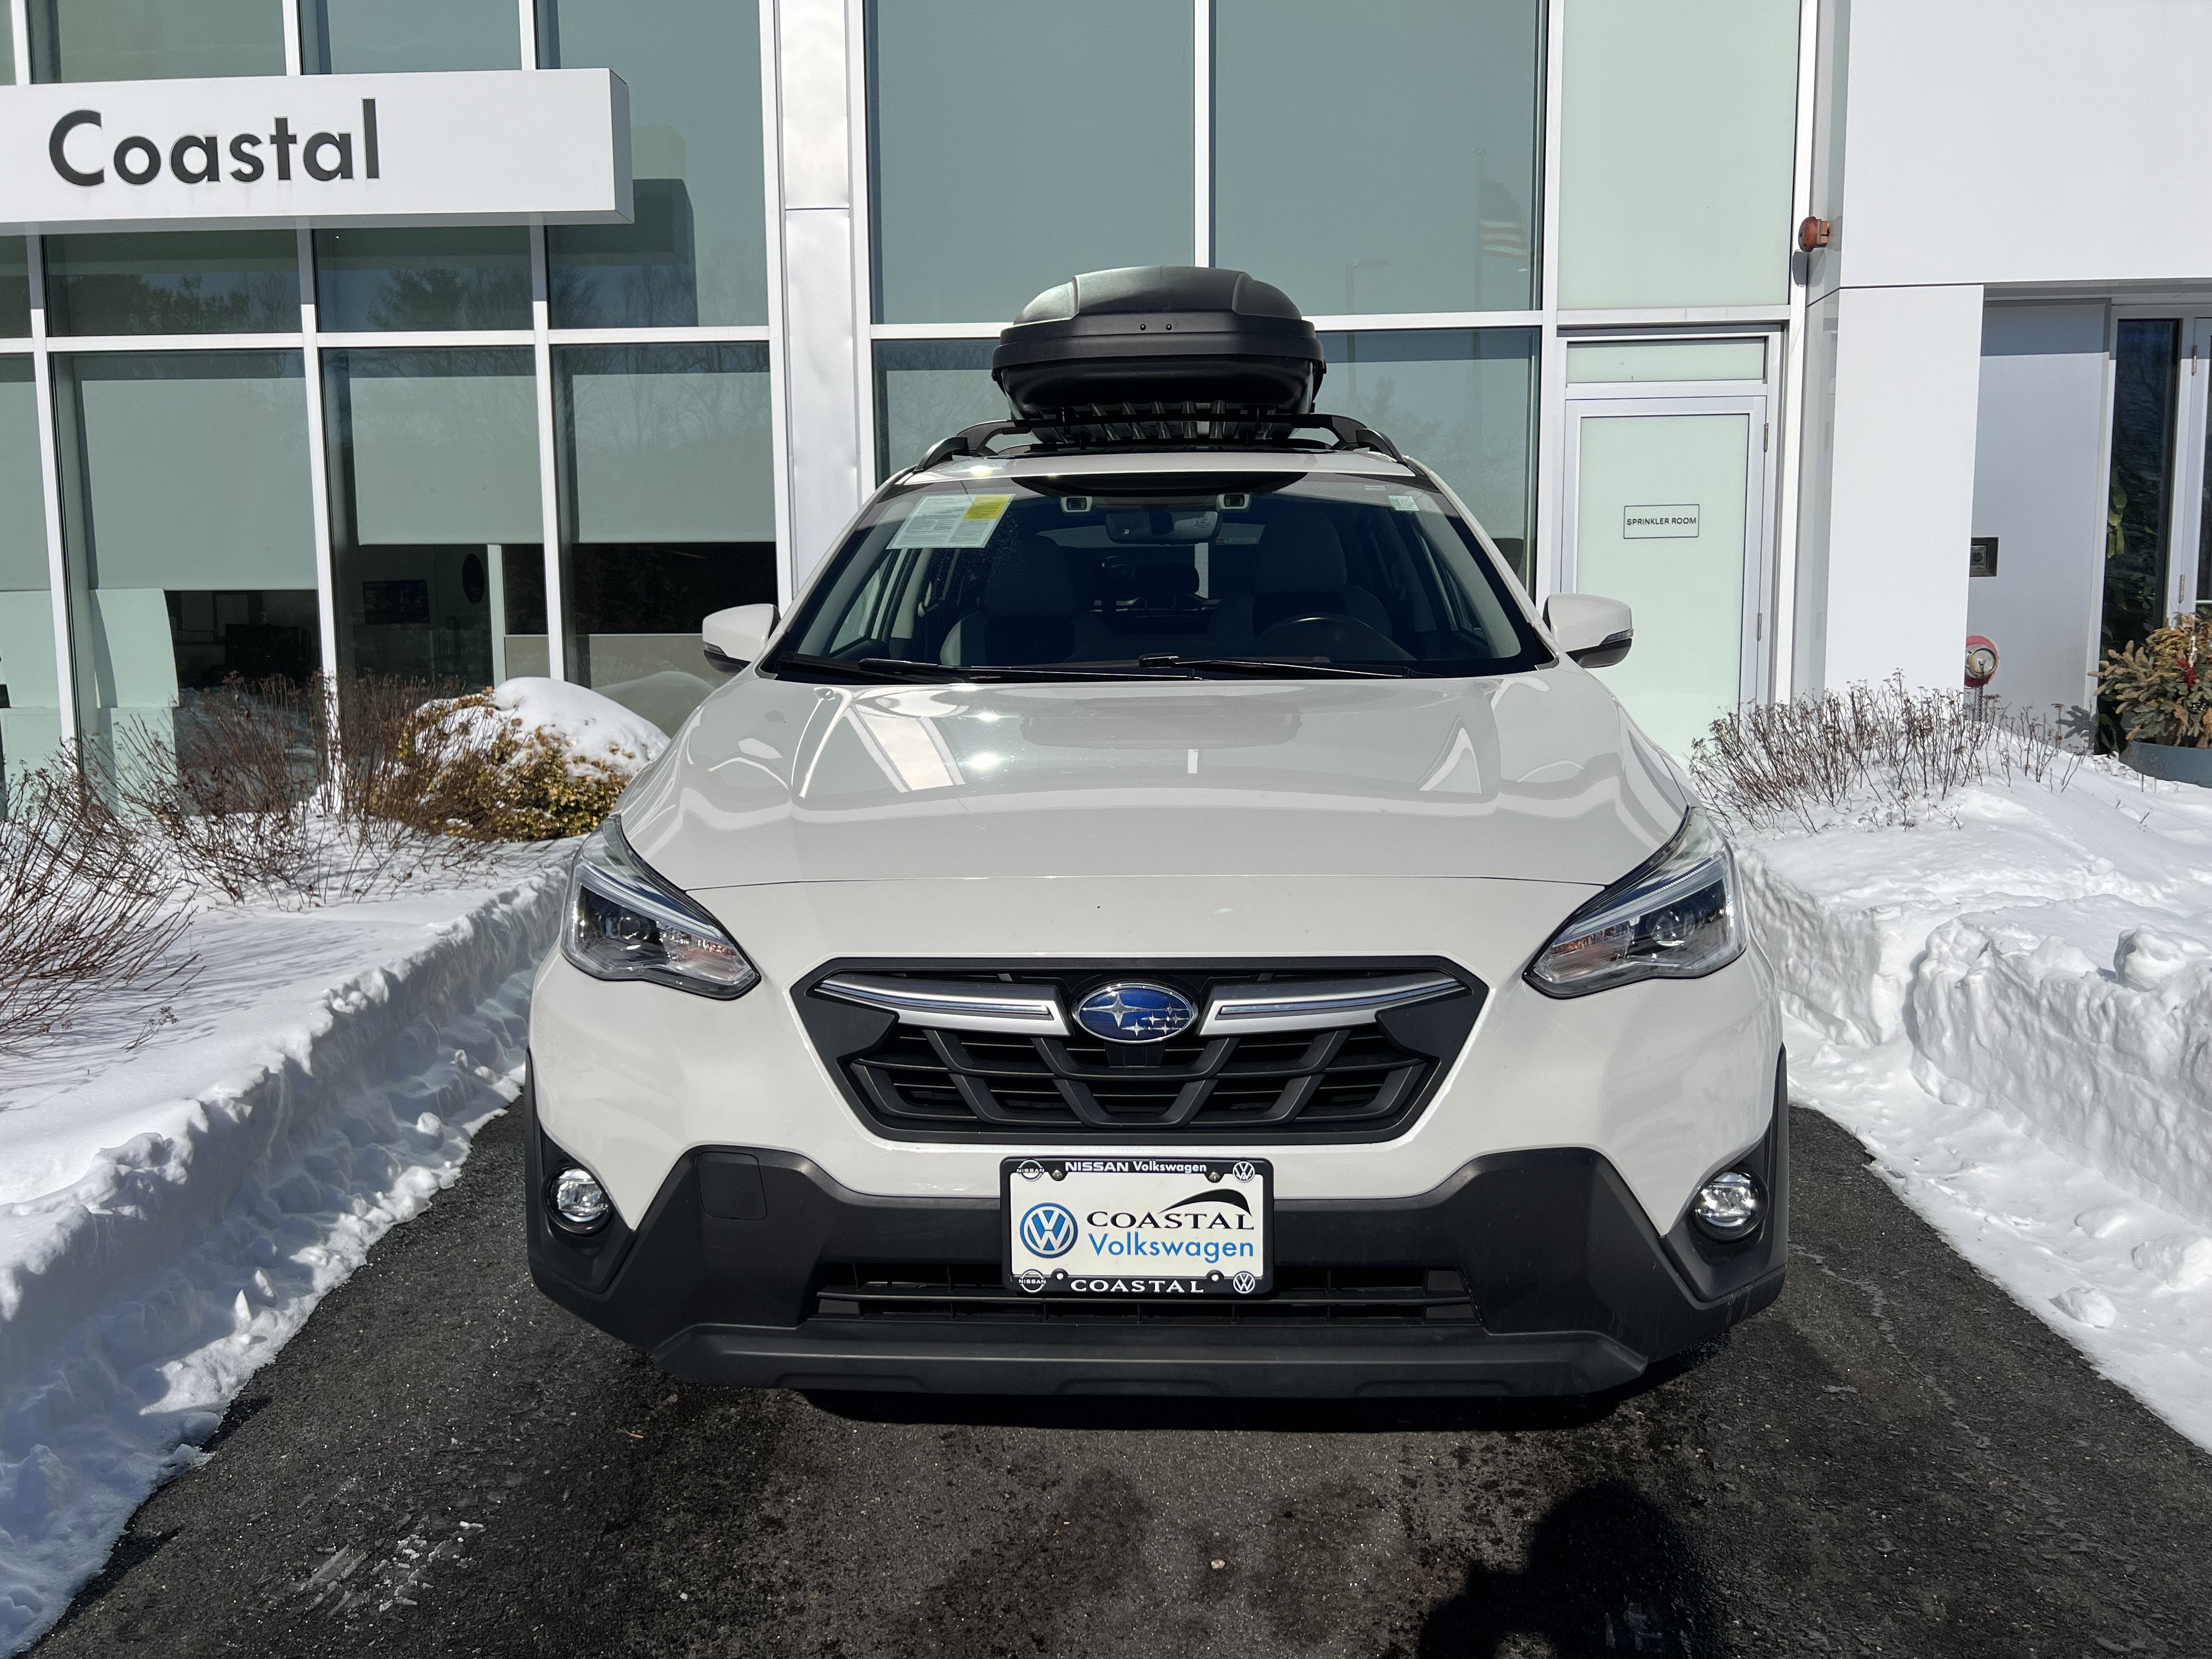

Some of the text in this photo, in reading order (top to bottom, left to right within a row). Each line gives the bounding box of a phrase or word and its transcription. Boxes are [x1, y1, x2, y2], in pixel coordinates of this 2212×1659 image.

[49, 97, 380, 187] Coastal
[1065, 1160, 1206, 1173] NISSAN Volkswagen
[1087, 1211, 1254, 1229] COASTAL
[1088, 1232, 1254, 1263] Volkswagen
[1070, 1279, 1204, 1293] COASTAL
